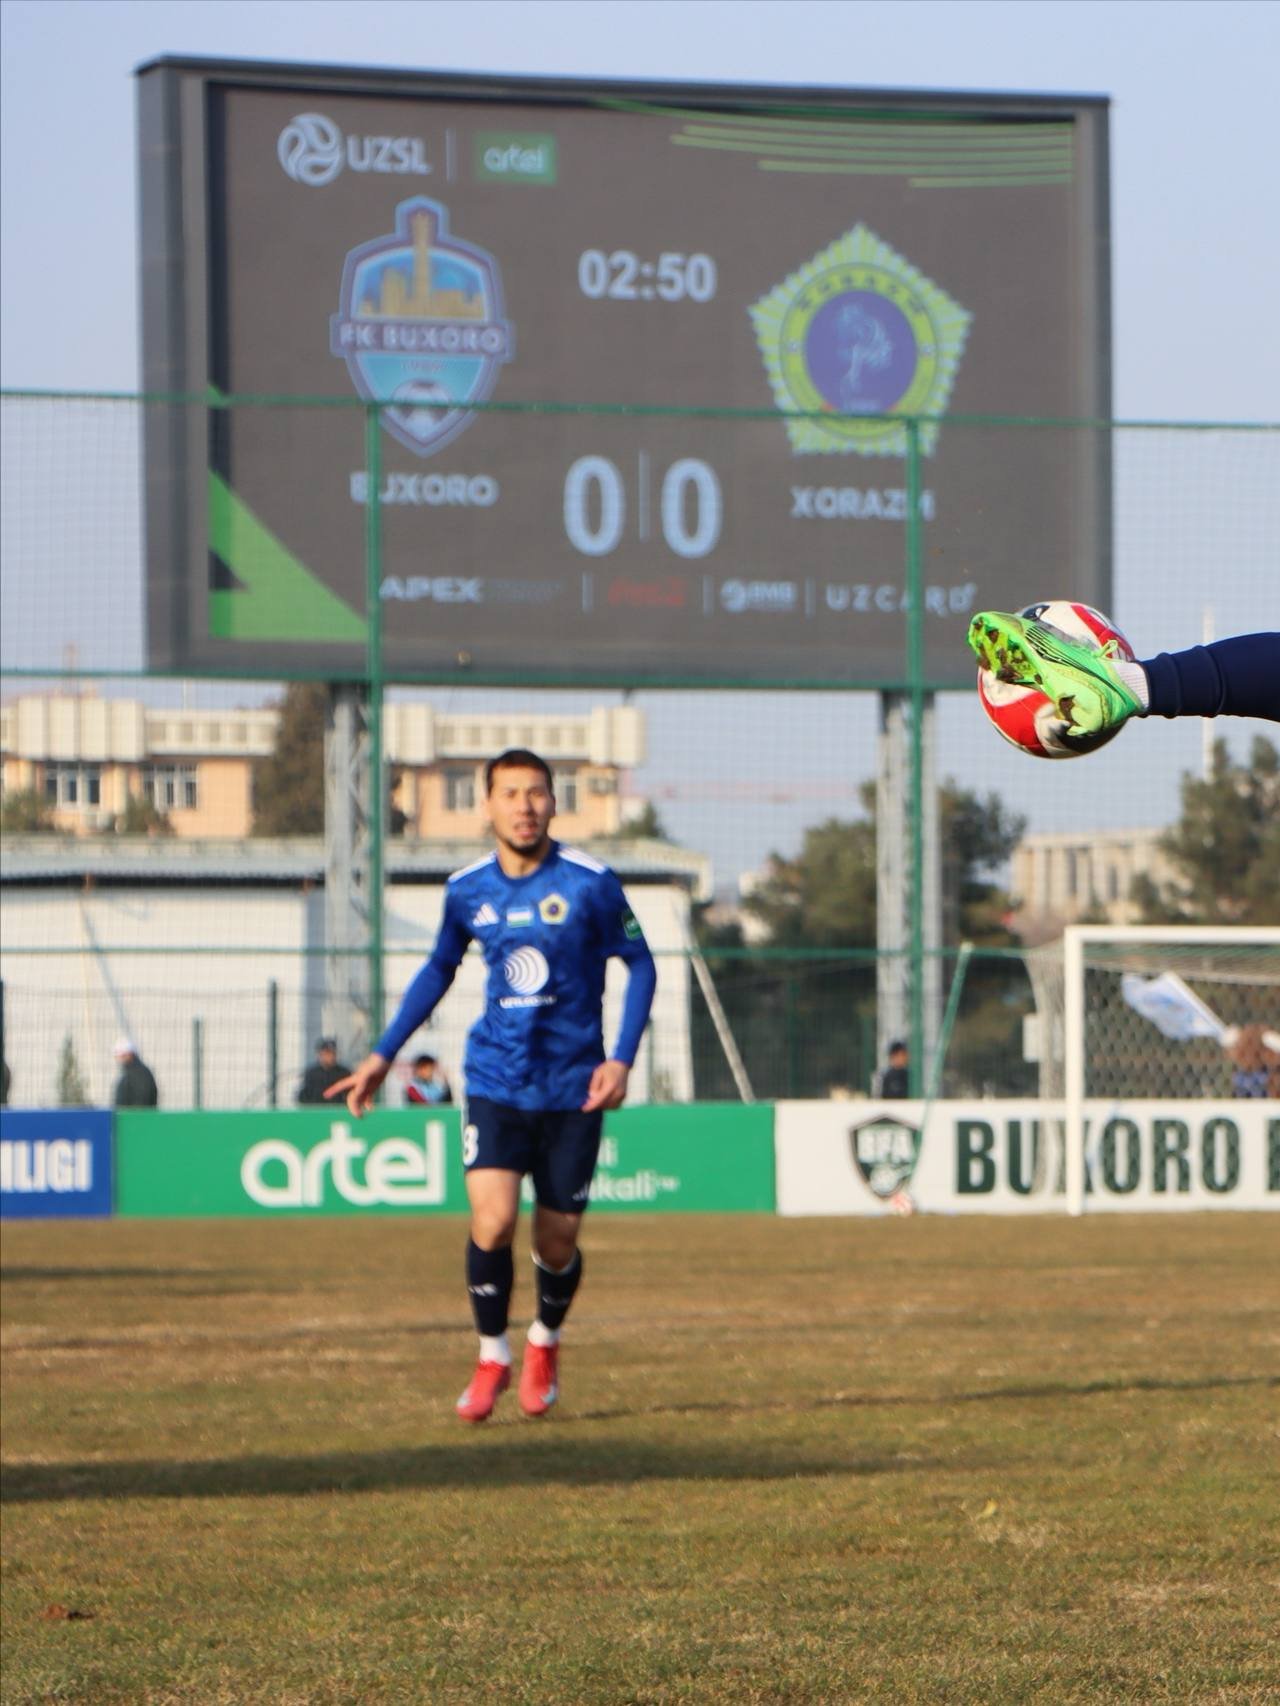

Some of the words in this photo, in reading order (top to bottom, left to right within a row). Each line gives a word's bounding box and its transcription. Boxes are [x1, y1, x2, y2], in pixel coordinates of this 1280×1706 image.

[346, 135, 432, 175] UZSL
[484, 145, 546, 174] artel
[578, 249, 718, 303] 02:50
[339, 322, 374, 347] FK
[382, 325, 503, 353] BUXORO
[564, 455, 626, 558] 0
[661, 458, 723, 560] 0
[378, 575, 482, 602] APEX
[240, 1120, 445, 1207] artel
